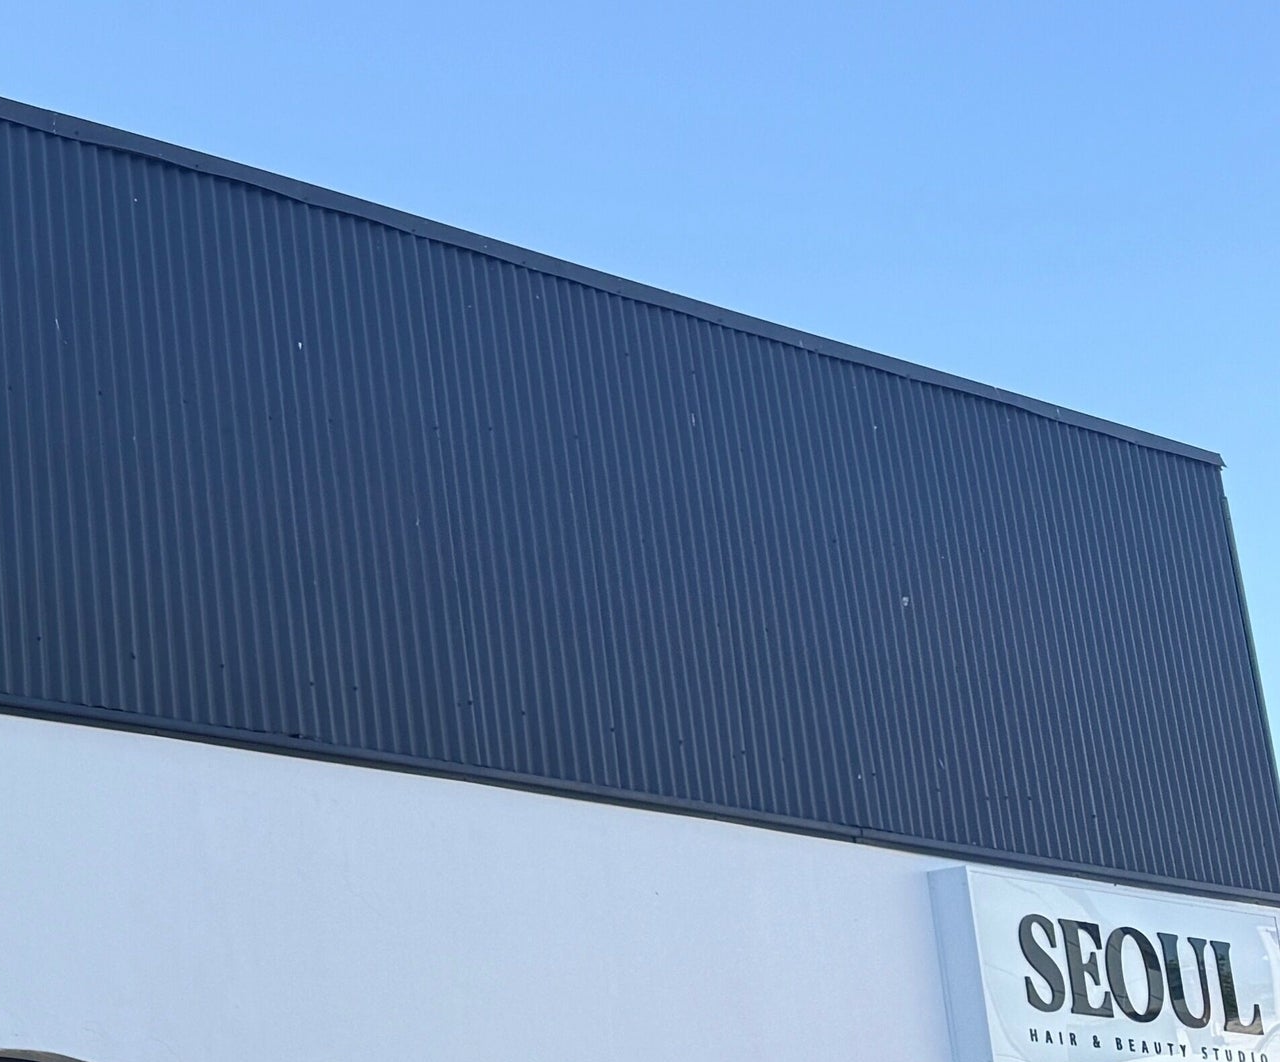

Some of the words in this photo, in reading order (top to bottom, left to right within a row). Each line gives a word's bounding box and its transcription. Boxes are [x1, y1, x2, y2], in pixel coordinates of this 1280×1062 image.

[1018, 913, 1264, 1035] SEOUL
[1029, 1028, 1078, 1046] HAIR
[1092, 1035, 1101, 1048] &
[1115, 1037, 1187, 1058] BEAUTY
